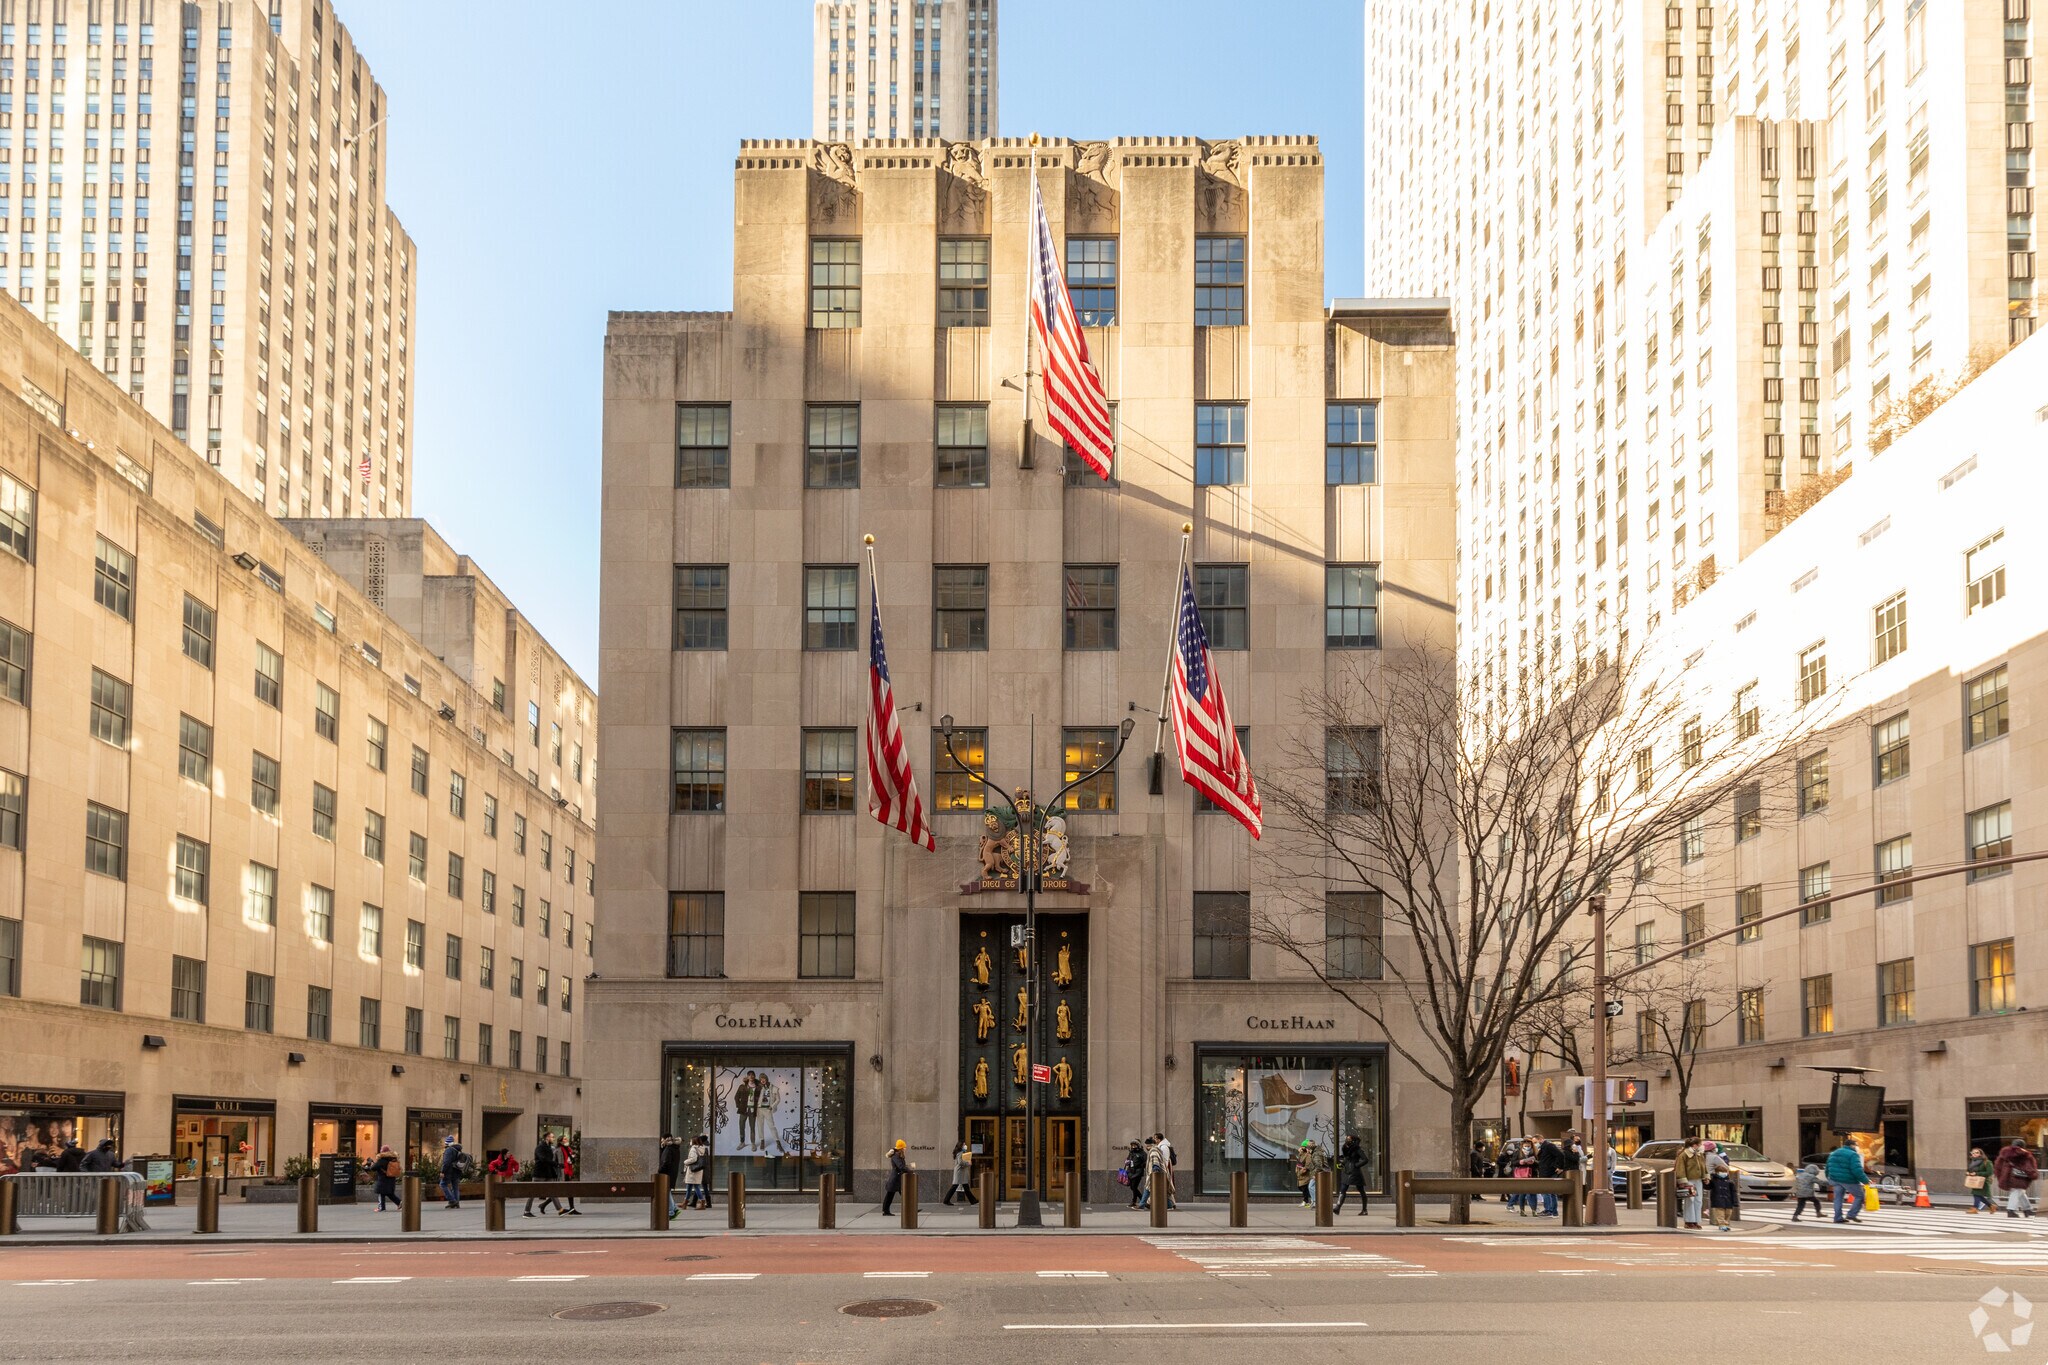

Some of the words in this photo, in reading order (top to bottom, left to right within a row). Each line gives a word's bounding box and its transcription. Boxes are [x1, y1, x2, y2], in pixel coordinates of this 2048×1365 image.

[0, 1092, 41, 1103] CHAEL
[45, 1093, 77, 1105] KORS
[1983, 1101, 2041, 1113] BANANA
